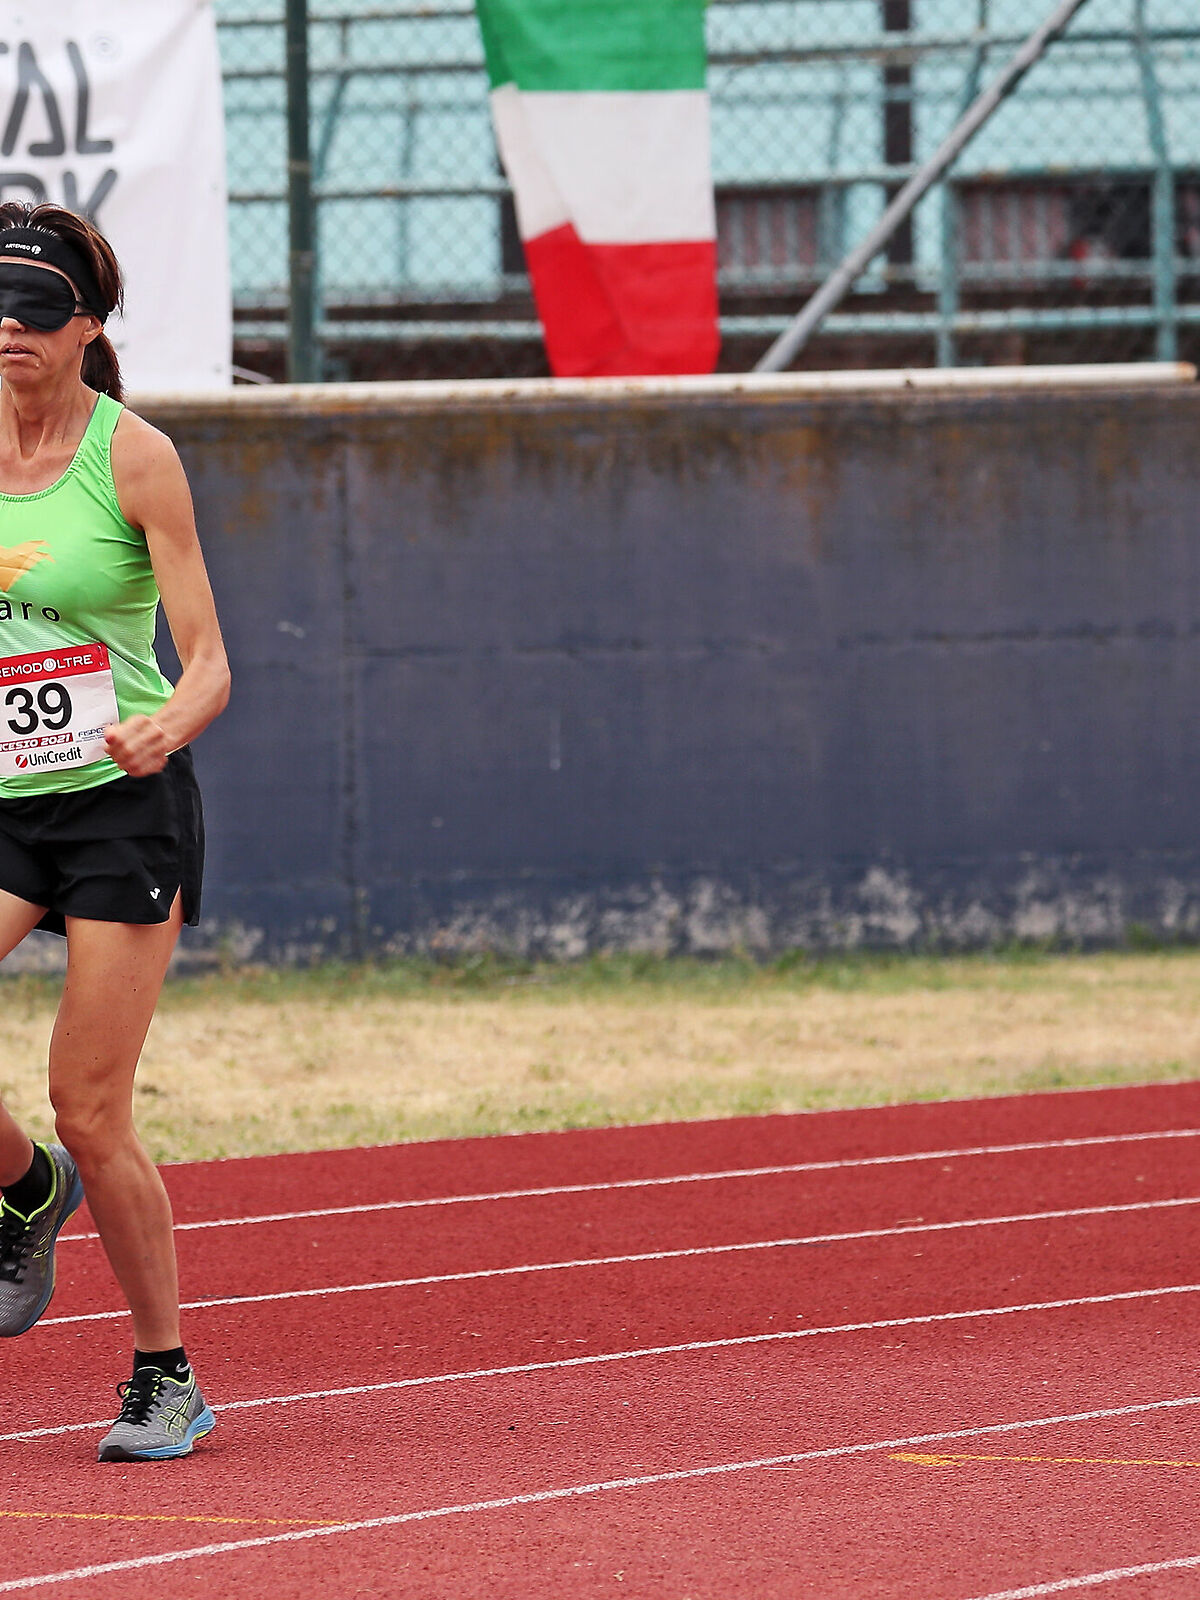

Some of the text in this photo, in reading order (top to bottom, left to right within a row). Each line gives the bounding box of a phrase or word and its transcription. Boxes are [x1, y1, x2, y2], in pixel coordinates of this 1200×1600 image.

[5, 682, 72, 735] 39
[40, 733, 72, 745] 2021
[28, 746, 83, 767] UniCredit
